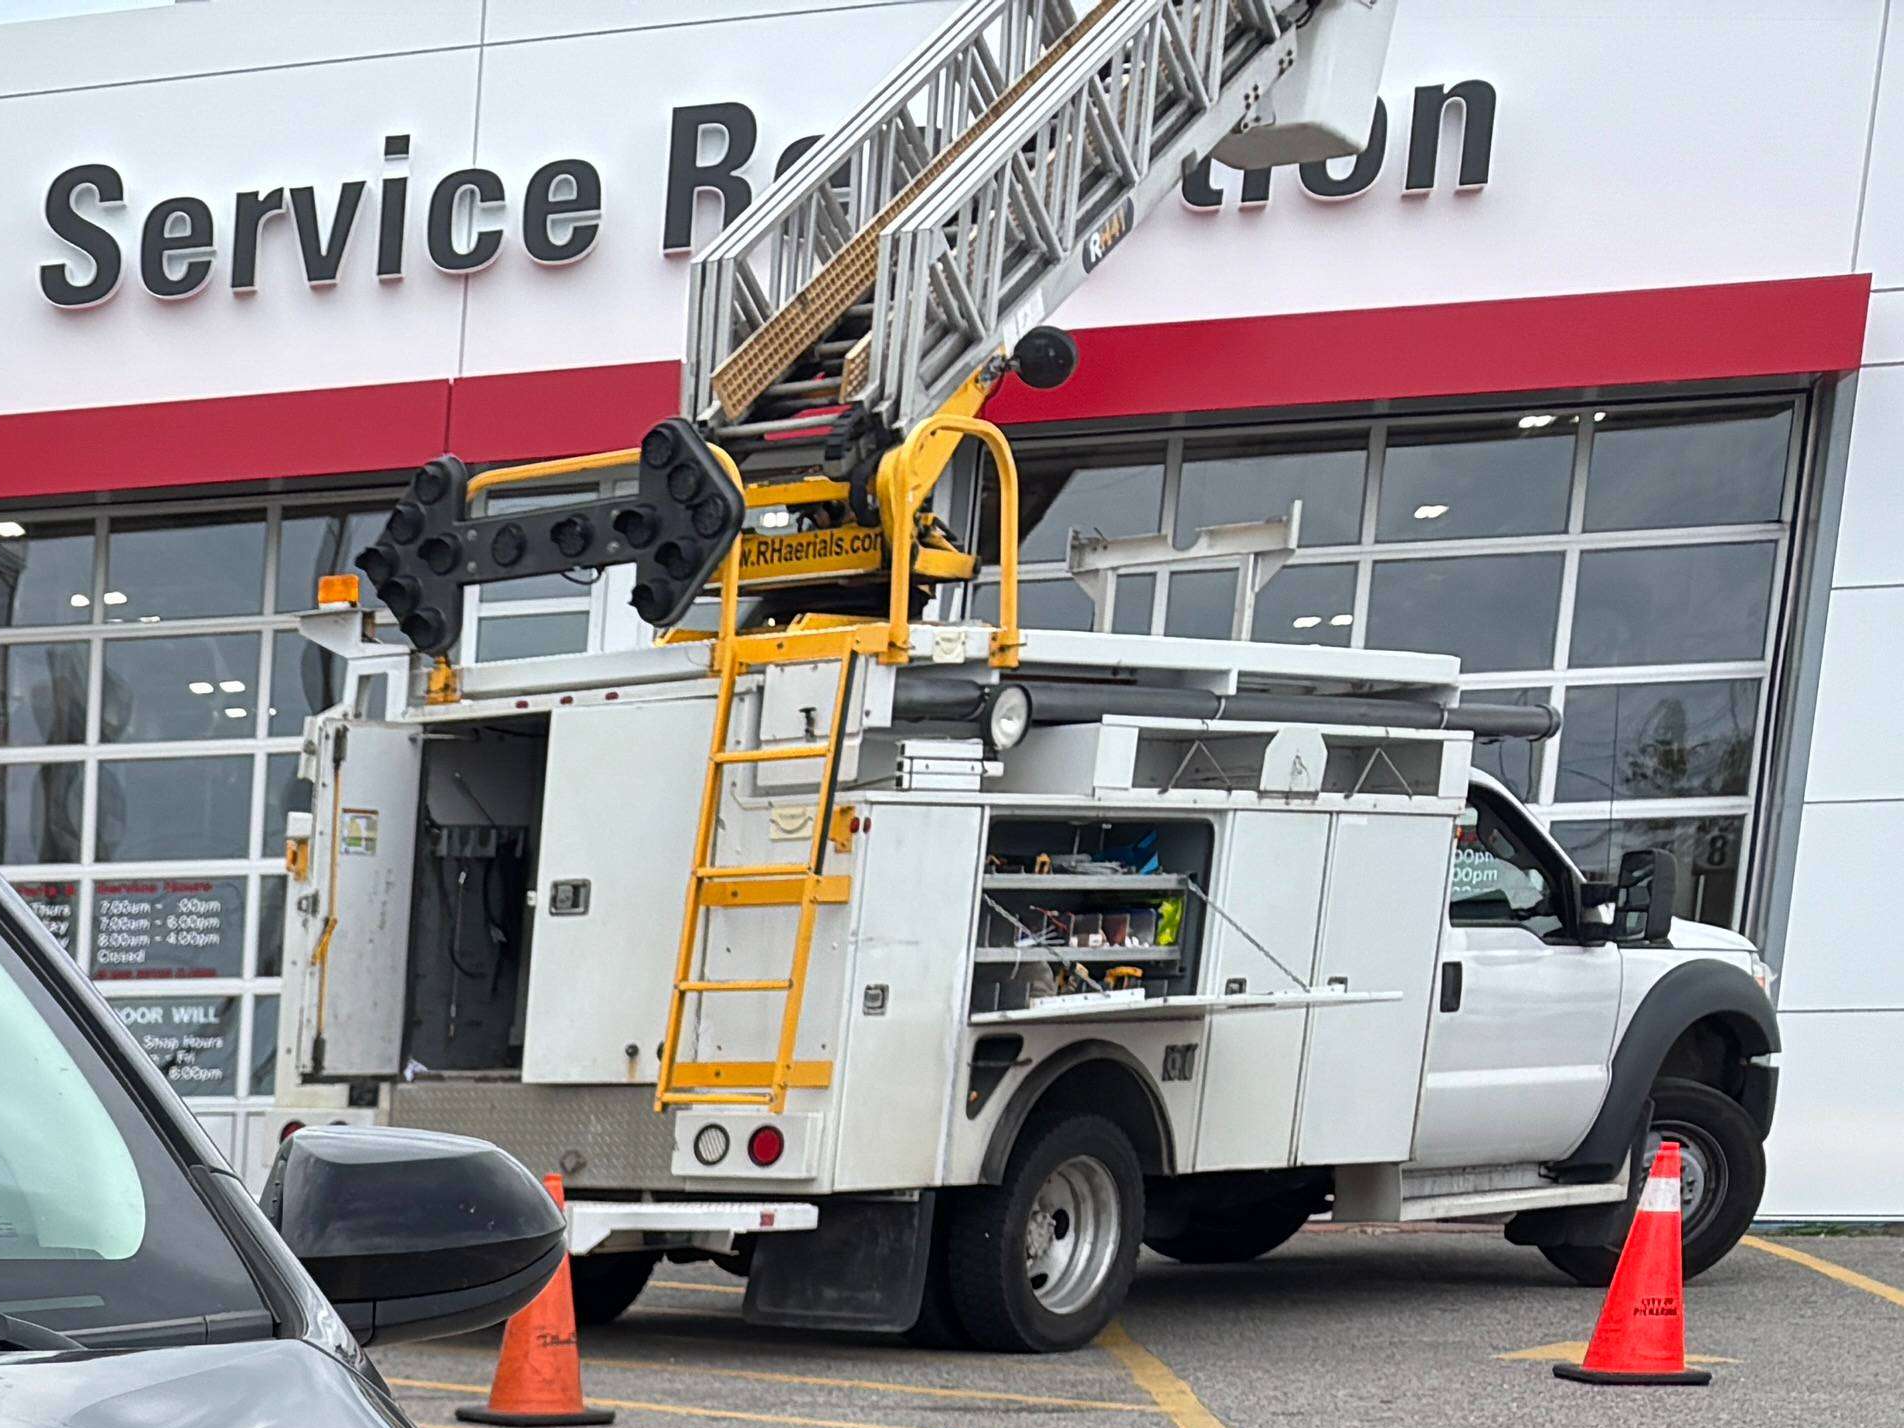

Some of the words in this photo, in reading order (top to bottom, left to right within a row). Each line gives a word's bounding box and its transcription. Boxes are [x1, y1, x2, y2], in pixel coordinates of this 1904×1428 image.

[39, 133, 603, 306] Service
[117, 1006, 164, 1025] OOR
[171, 1006, 221, 1024] WILL
